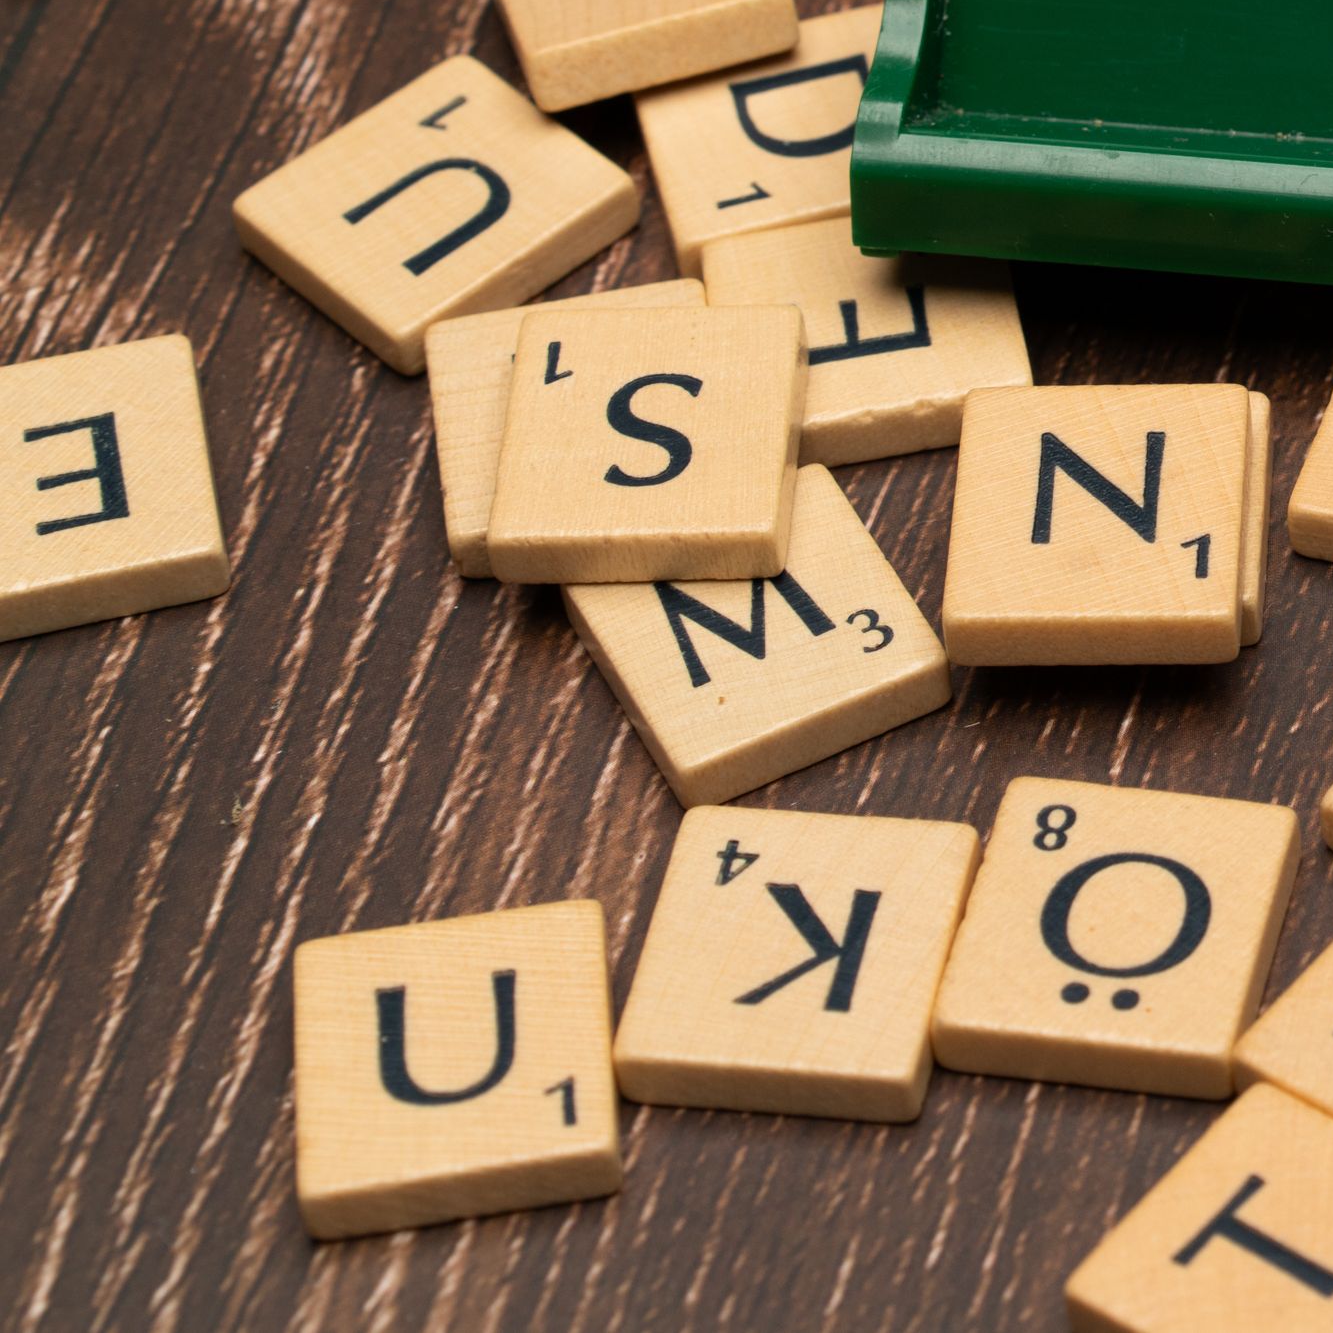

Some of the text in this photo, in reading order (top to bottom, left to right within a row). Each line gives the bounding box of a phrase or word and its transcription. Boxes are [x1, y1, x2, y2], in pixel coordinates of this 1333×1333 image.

[344, 97, 510, 276] U 1
[718, 52, 869, 209] D 1
[24, 412, 129, 535] E
[545, 342, 702, 486] S 1
[1031, 432, 1210, 578] N 1
[653, 572, 893, 688] M 3
[718, 840, 881, 1012] K 4
[1033, 805, 1211, 1010] Ö 8
[376, 970, 579, 1127] U 1
